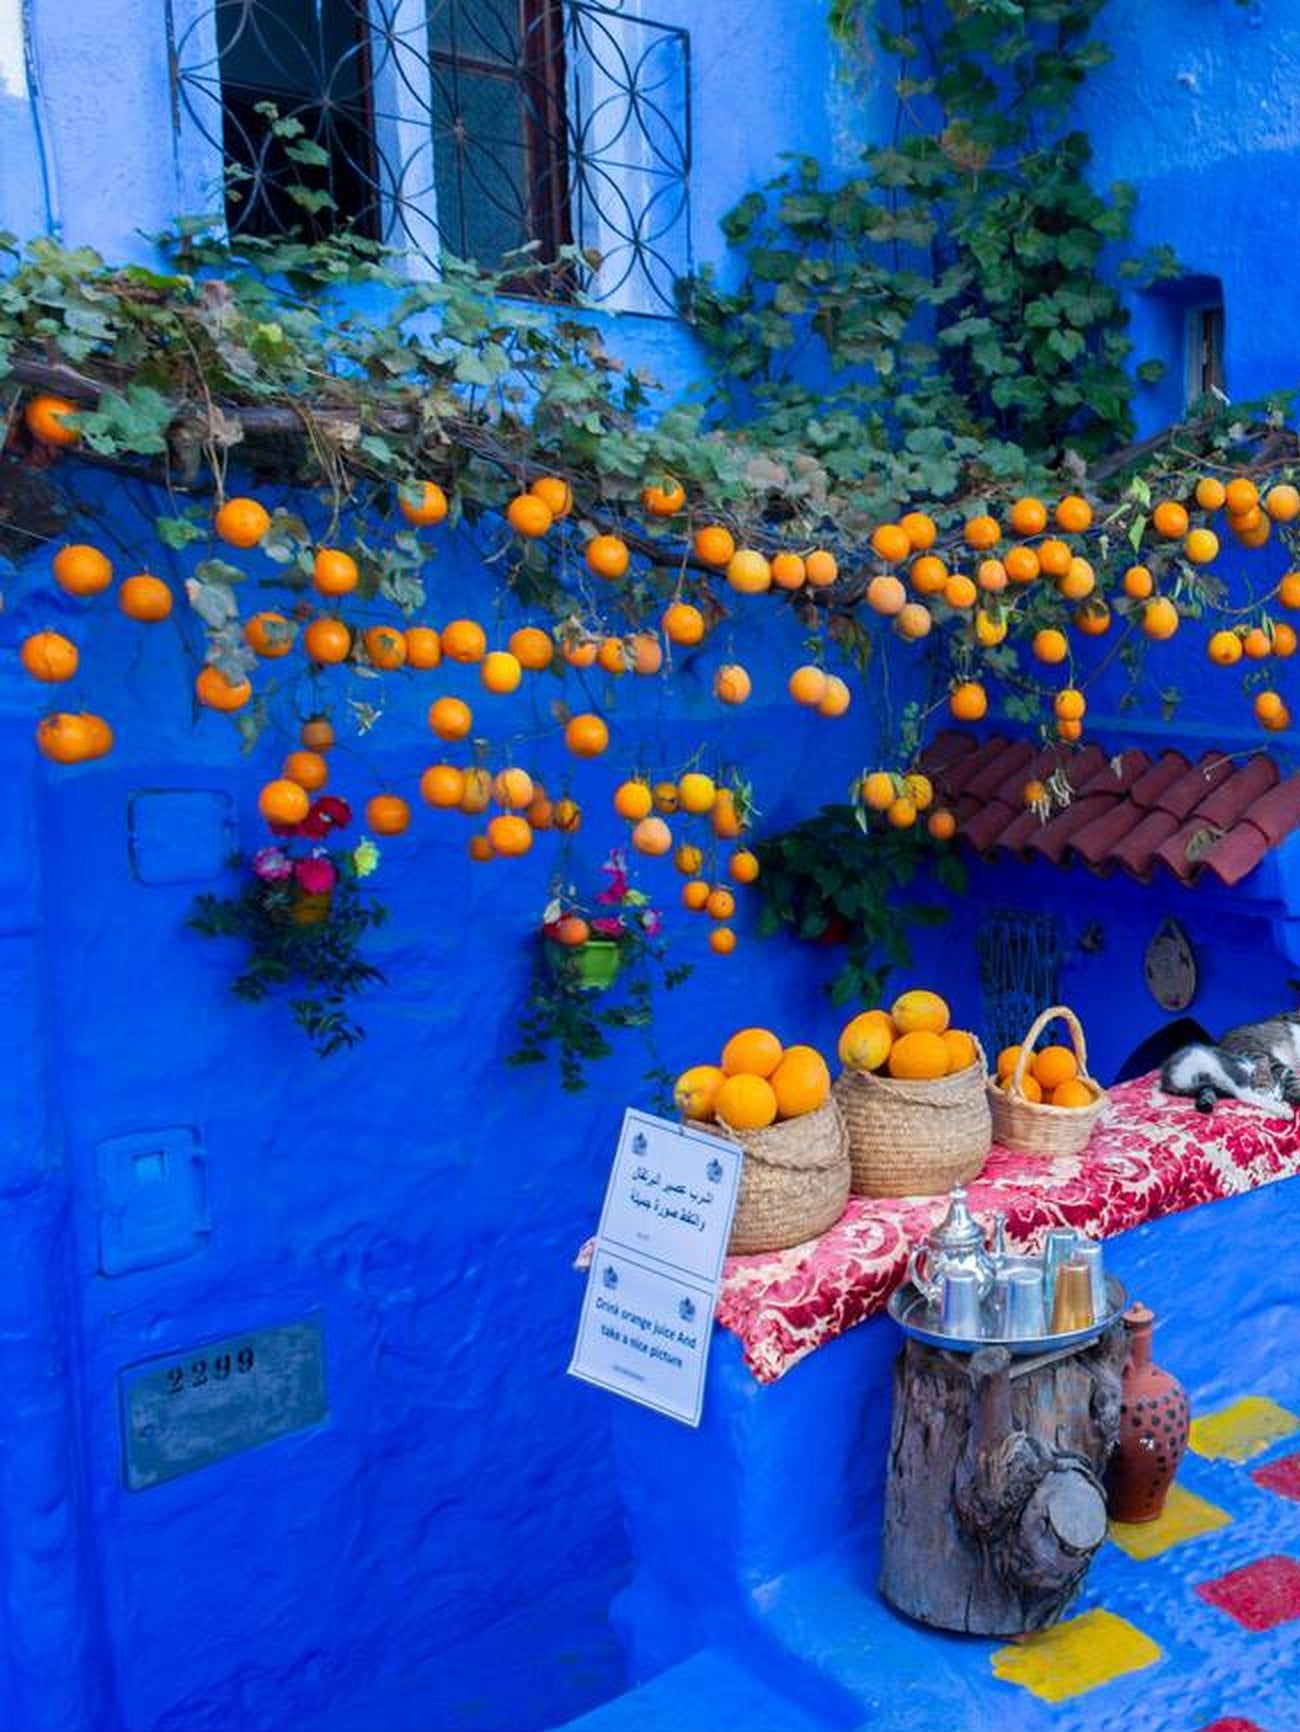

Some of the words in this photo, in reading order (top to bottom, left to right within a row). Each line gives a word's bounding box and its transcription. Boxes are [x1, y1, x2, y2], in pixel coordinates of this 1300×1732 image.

[596, 1296, 619, 1315] Drink
[621, 1309, 652, 1331] orange
[652, 1324, 675, 1341] juice
[677, 1331, 697, 1349] And
[601, 1325, 620, 1341] take
[629, 1338, 649, 1354] nice
[649, 1347, 683, 1368] picture
[167, 1347, 255, 1395] 2299
